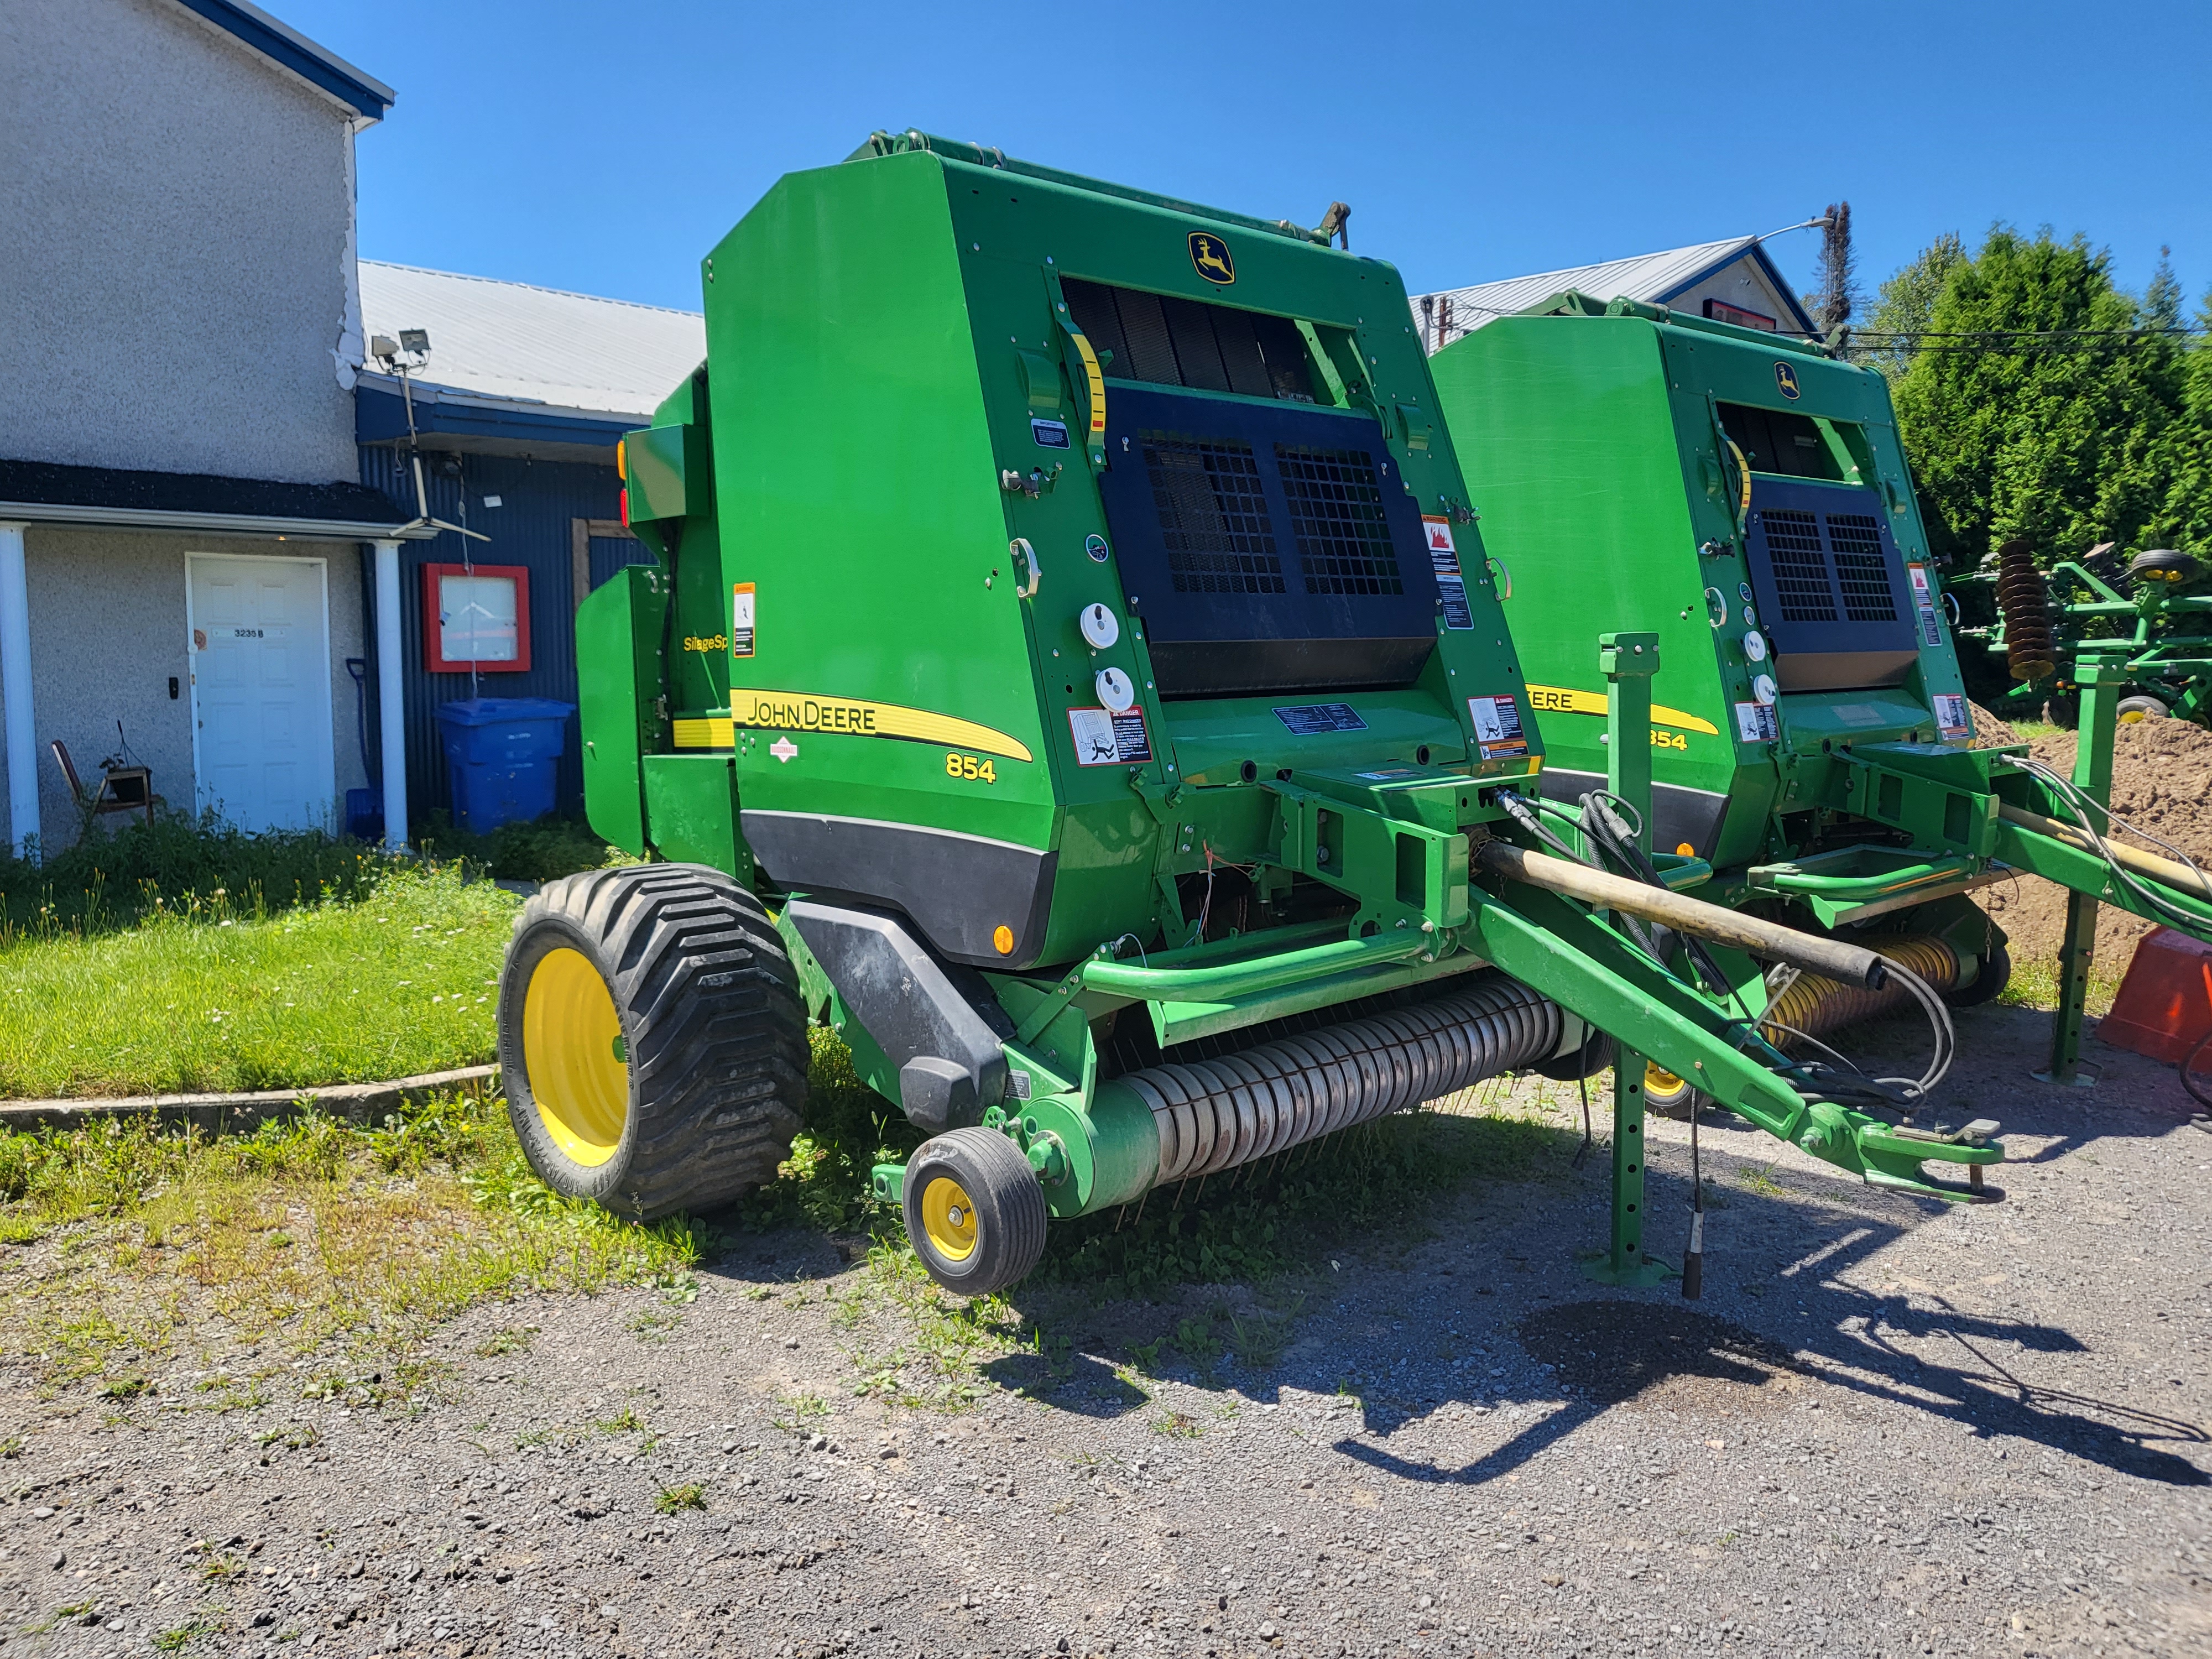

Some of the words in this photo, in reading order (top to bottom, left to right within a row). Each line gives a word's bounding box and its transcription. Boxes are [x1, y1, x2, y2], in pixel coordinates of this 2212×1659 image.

[748, 697, 800, 725] JOHN
[805, 701, 875, 730] DEERE
[1527, 691, 1572, 708] ERE
[946, 752, 997, 784] 854
